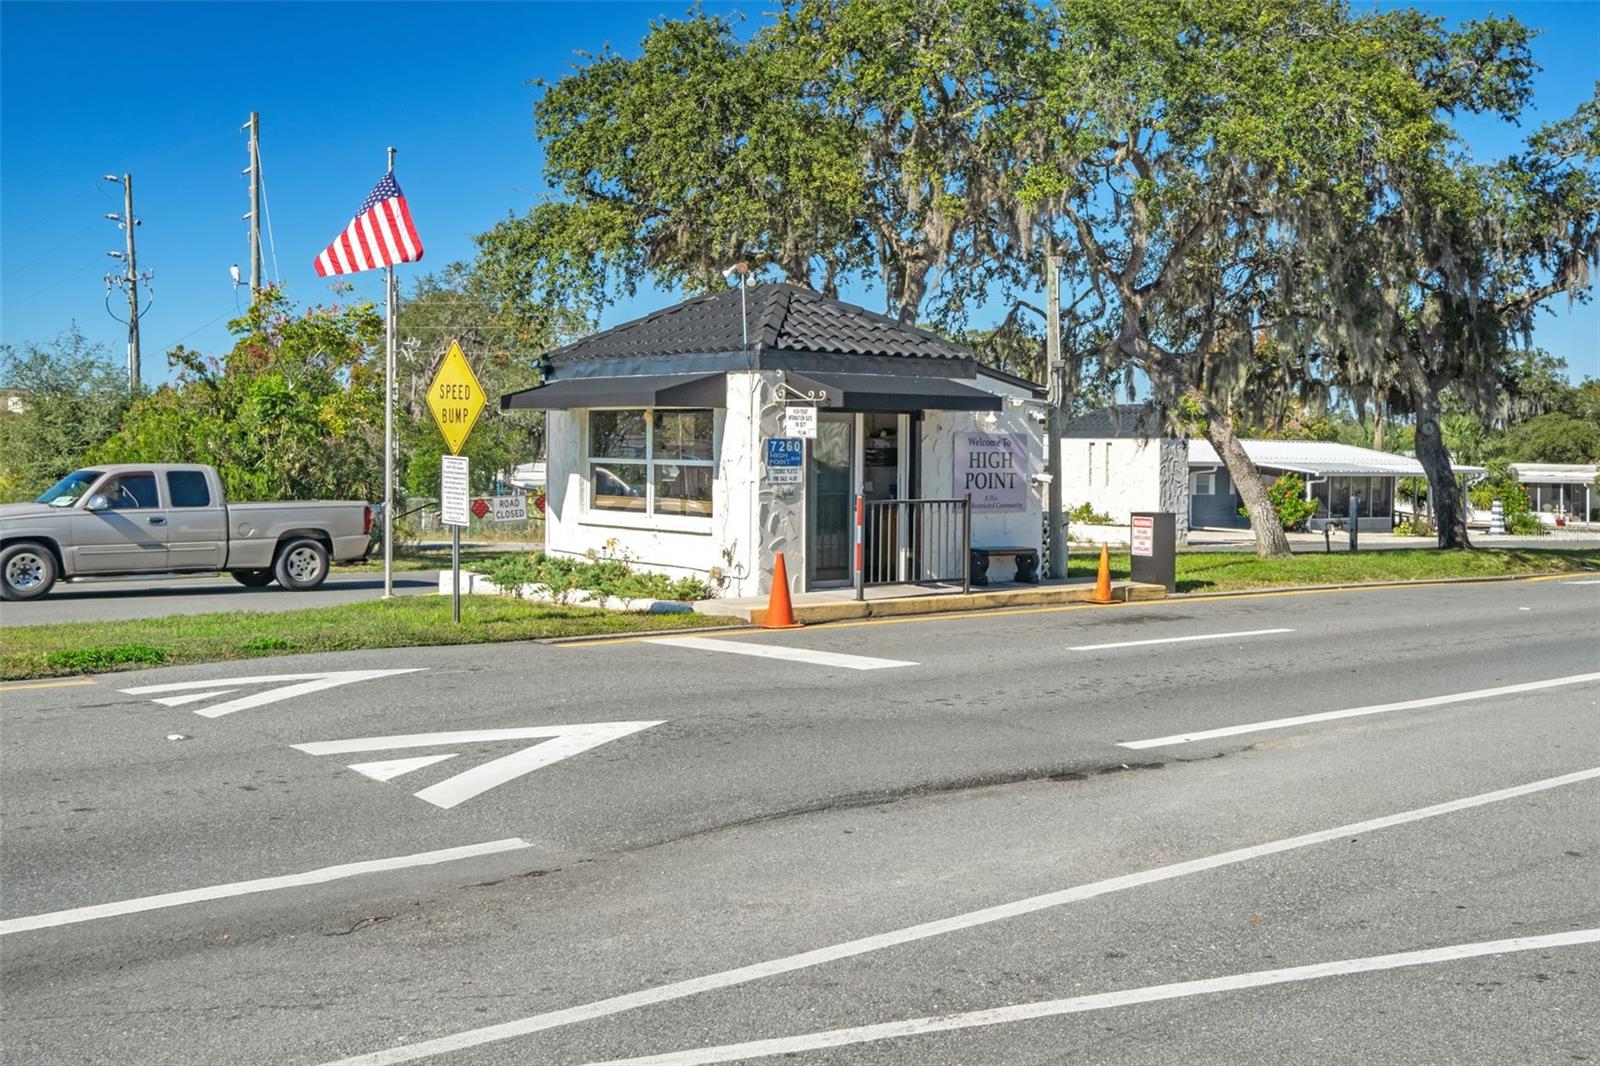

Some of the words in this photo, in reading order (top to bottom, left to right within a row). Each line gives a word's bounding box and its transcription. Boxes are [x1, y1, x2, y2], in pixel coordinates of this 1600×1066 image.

[440, 384, 470, 400] SPEED
[442, 408, 468, 424] BUMP
[770, 441, 800, 452] 7260
[968, 437, 1000, 447] Welcome
[1002, 438, 1011, 447] To
[968, 451, 1013, 469] HIGH
[965, 472, 1017, 489] POINT
[499, 499, 519, 508] ROAD
[496, 509, 524, 519] CLOSED
